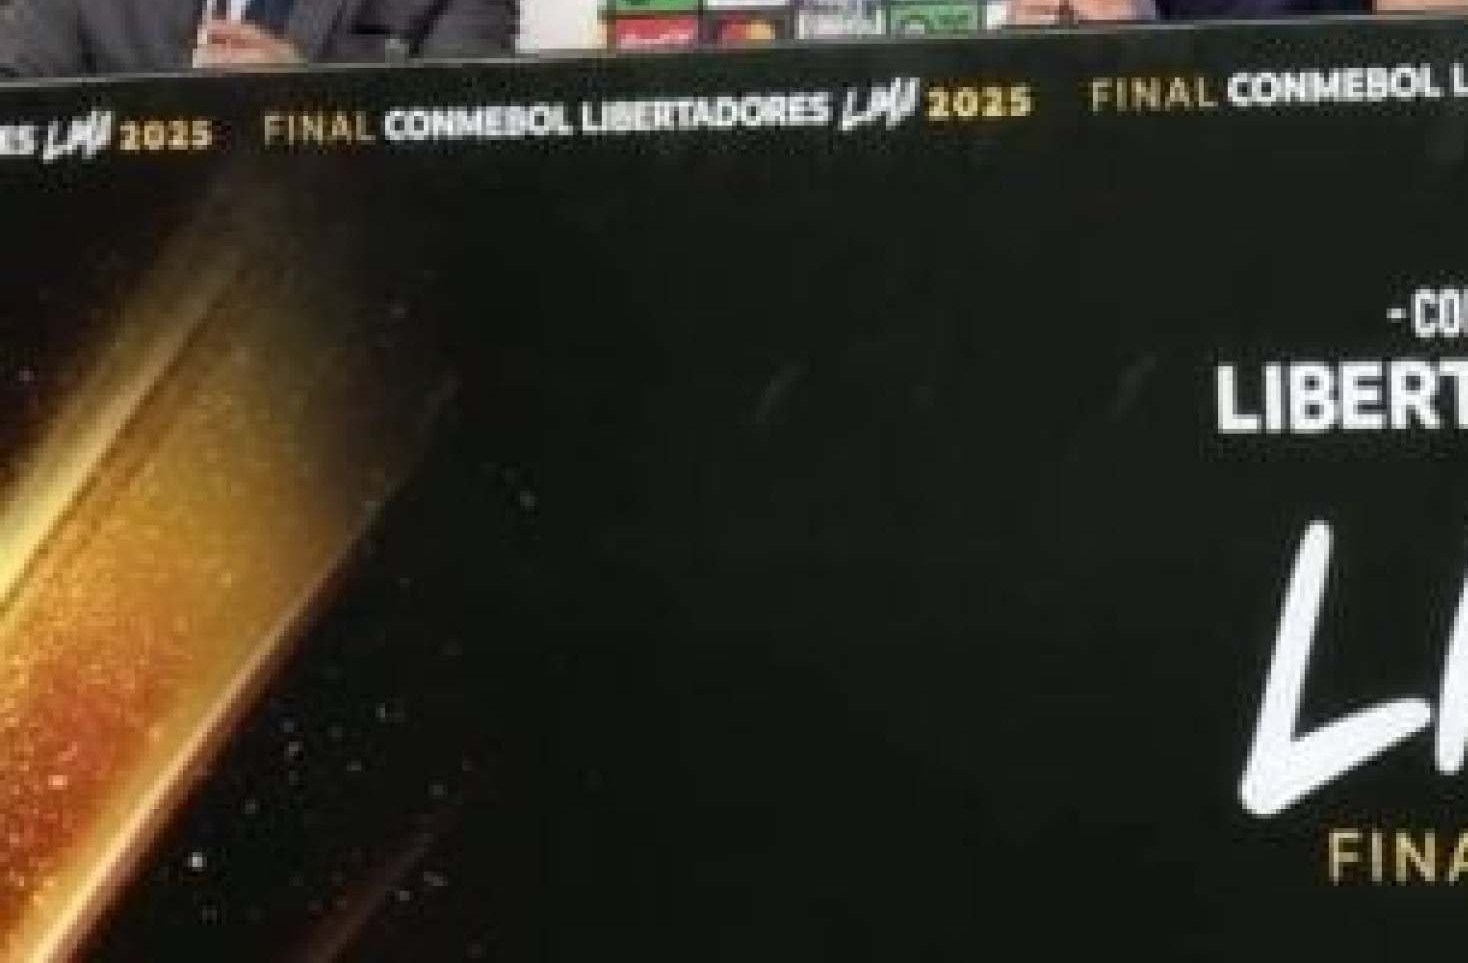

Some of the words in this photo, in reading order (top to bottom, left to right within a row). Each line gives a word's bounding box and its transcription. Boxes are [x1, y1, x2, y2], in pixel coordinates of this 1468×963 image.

[1088, 76, 1219, 113] FINAL
[1227, 61, 1446, 107] CONMEBOL
[119, 119, 214, 152] 2025
[263, 109, 376, 146] FINAL
[384, 100, 573, 142] CONMEBOL
[581, 90, 833, 133] LIBERTADORES
[927, 84, 1035, 118] 2025
